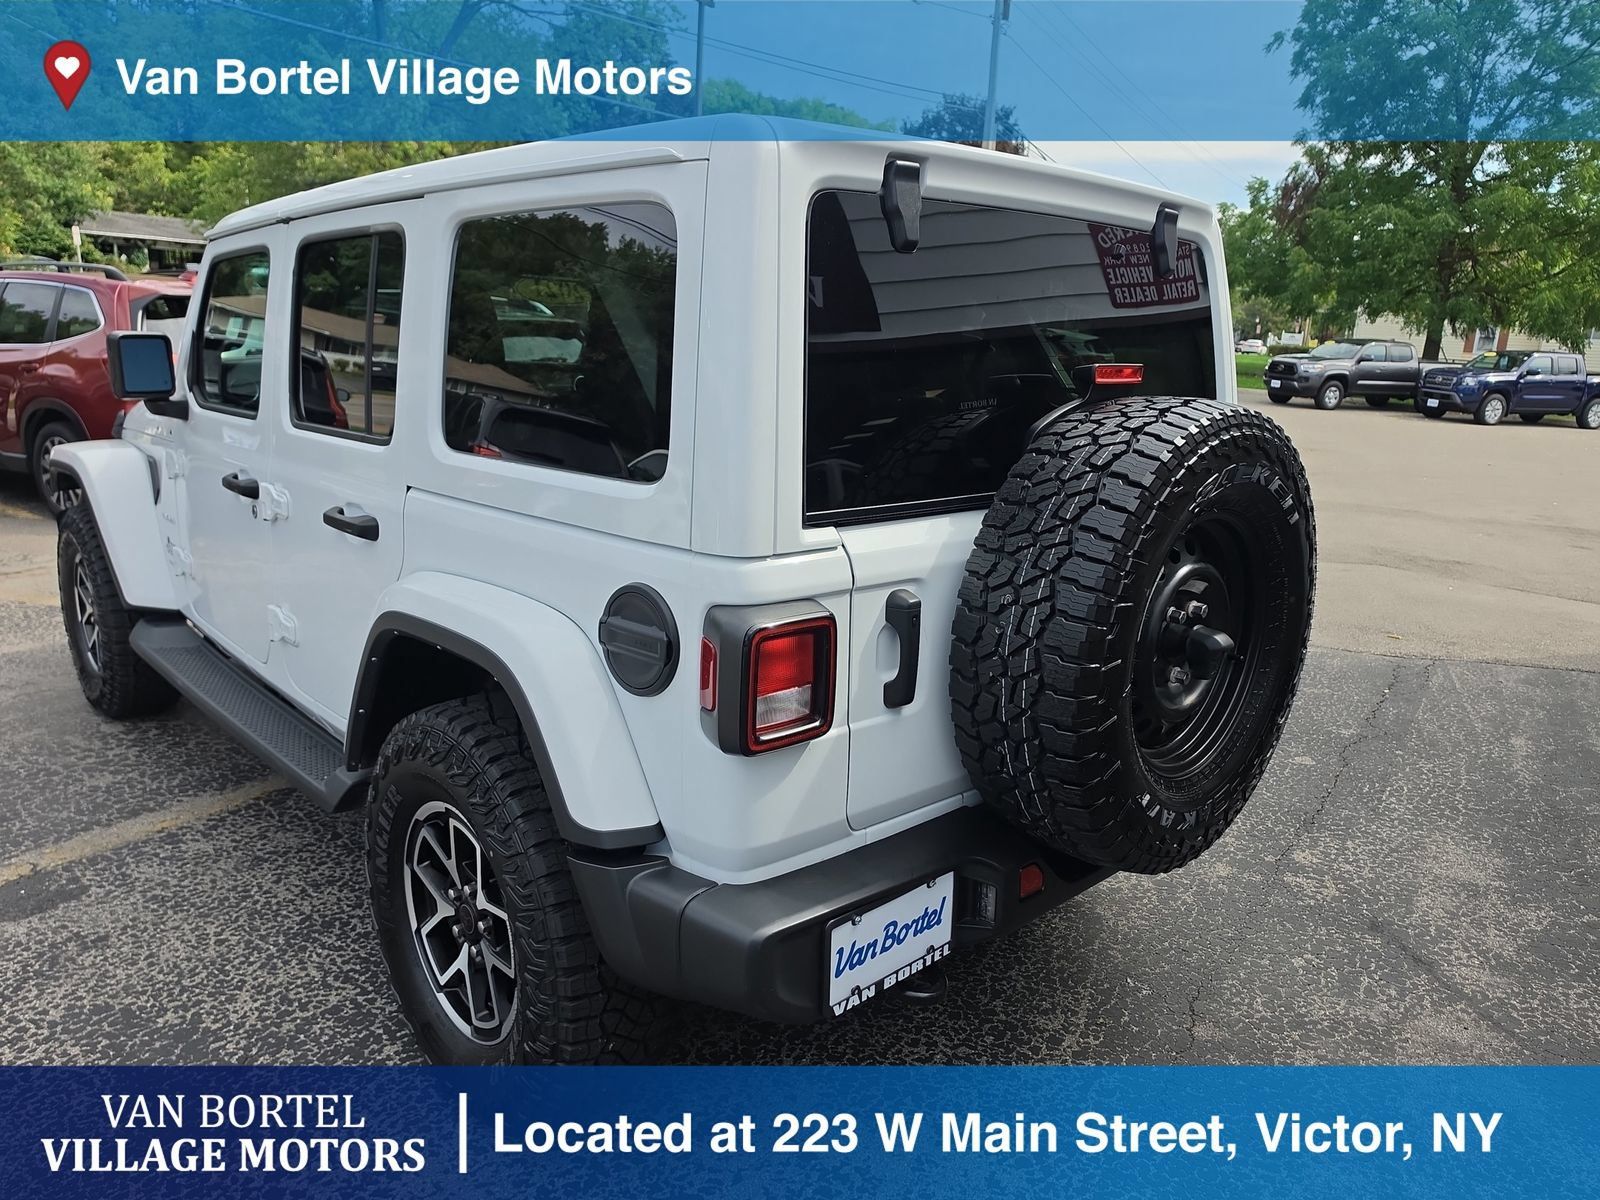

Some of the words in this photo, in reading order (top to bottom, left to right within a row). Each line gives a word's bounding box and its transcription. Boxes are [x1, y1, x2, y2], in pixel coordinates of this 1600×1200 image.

[834, 938, 879, 979] Van
[878, 895, 948, 956] Bortel
[832, 984, 876, 1017] VAN
[883, 943, 951, 990] BORTEL
